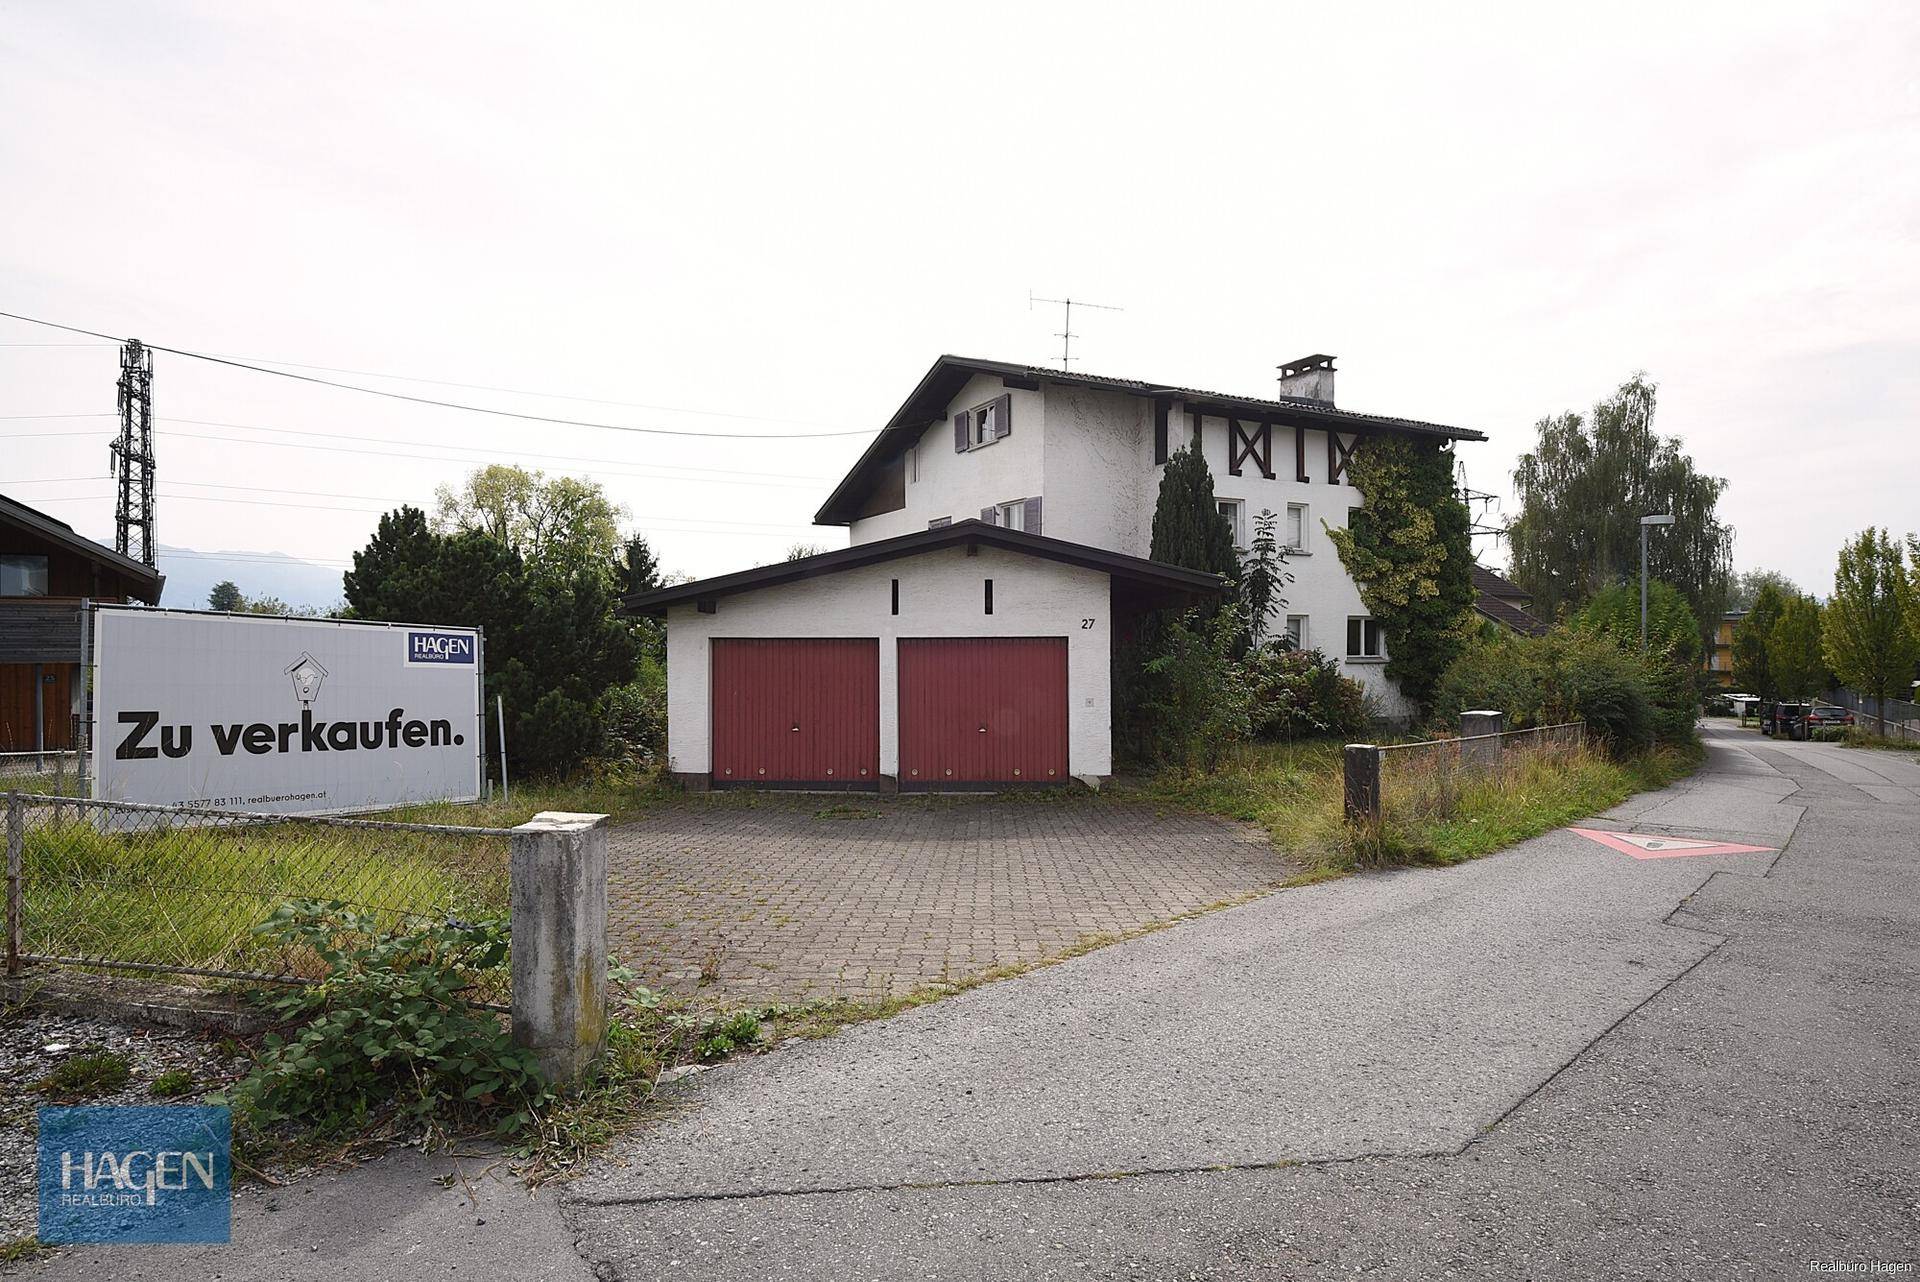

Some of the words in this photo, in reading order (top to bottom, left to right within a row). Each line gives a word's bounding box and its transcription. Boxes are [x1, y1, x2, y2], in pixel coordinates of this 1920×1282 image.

[1081, 618, 1095, 629] 27
[414, 636, 469, 660] HAGEN
[115, 711, 192, 760] Zu
[211, 708, 464, 756] verkaufen.
[187, 799, 211, 809] 5577
[214, 798, 226, 807] 83
[230, 796, 246, 806] 111,
[247, 790, 327, 805] realbuerohagen.at
